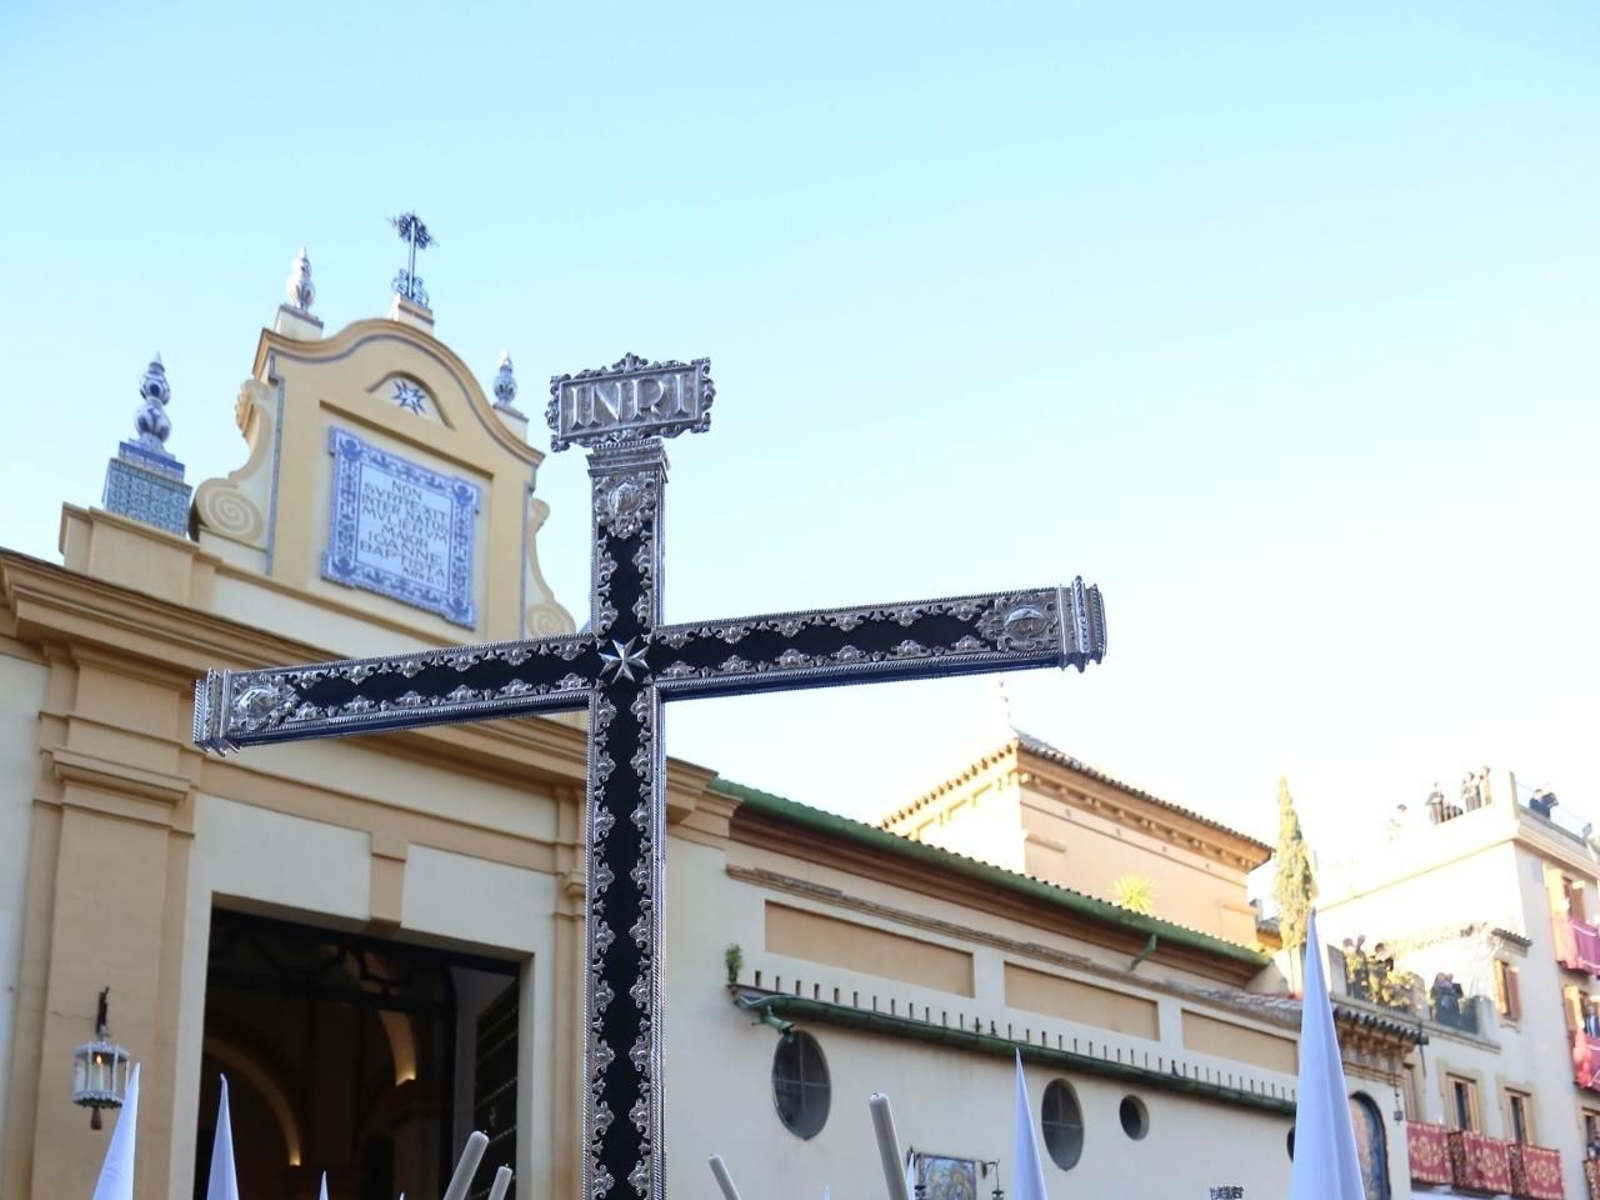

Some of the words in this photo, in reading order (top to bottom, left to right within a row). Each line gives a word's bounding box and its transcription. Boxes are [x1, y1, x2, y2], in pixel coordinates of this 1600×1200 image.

[569, 374, 689, 431] INRI
[392, 481, 421, 500] NON
[362, 494, 399, 514] INTER
[406, 511, 448, 533] NATOS
[362, 506, 446, 543] MVLIERVM
[368, 531, 441, 564] IOANNE
[381, 525, 427, 547] MAIOR
[360, 541, 445, 577] BAPTISTA
